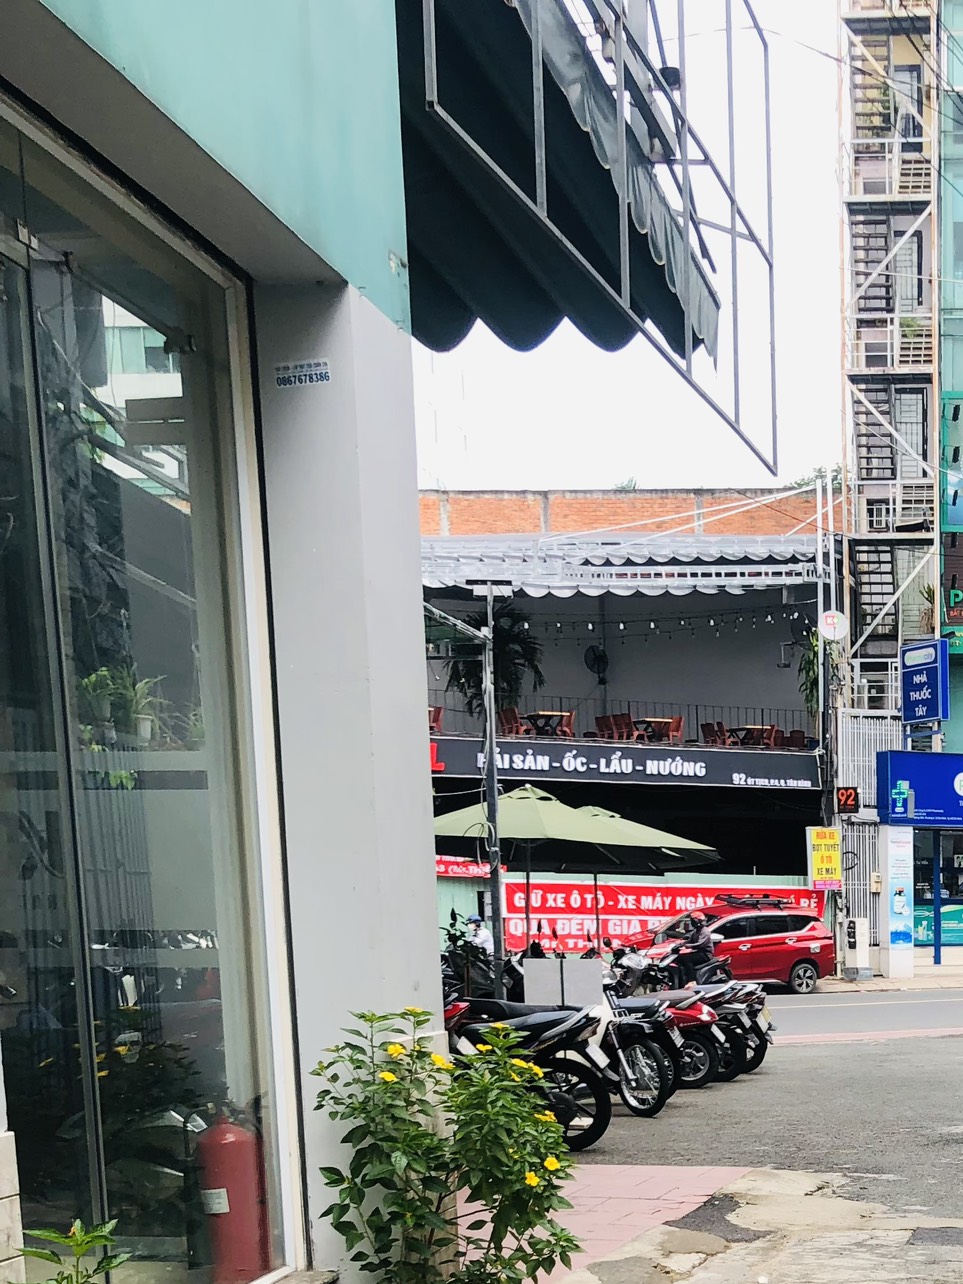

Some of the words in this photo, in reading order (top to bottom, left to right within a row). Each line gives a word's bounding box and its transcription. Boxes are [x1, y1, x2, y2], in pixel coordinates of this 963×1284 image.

[276, 371, 330, 387] 0867678386
[909, 685, 932, 701] THUỐC
[915, 704, 927, 716] TÂY
[512, 749, 550, 771] SẢN
[562, 749, 588, 772] ỐC
[599, 751, 633, 774] LẨU
[645, 756, 707, 777] NƯỚNG
[732, 773, 747, 785] 92
[838, 789, 856, 805] 92
[816, 867, 824, 876] XE
[824, 865, 837, 876] MÁY
[513, 889, 543, 908] GỮ
[545, 893, 567, 908] XE
[569, 889, 582, 909] Ô
[617, 894, 637, 909] XE
[640, 892, 673, 910] MÁY
[675, 893, 715, 910] NGÀY
